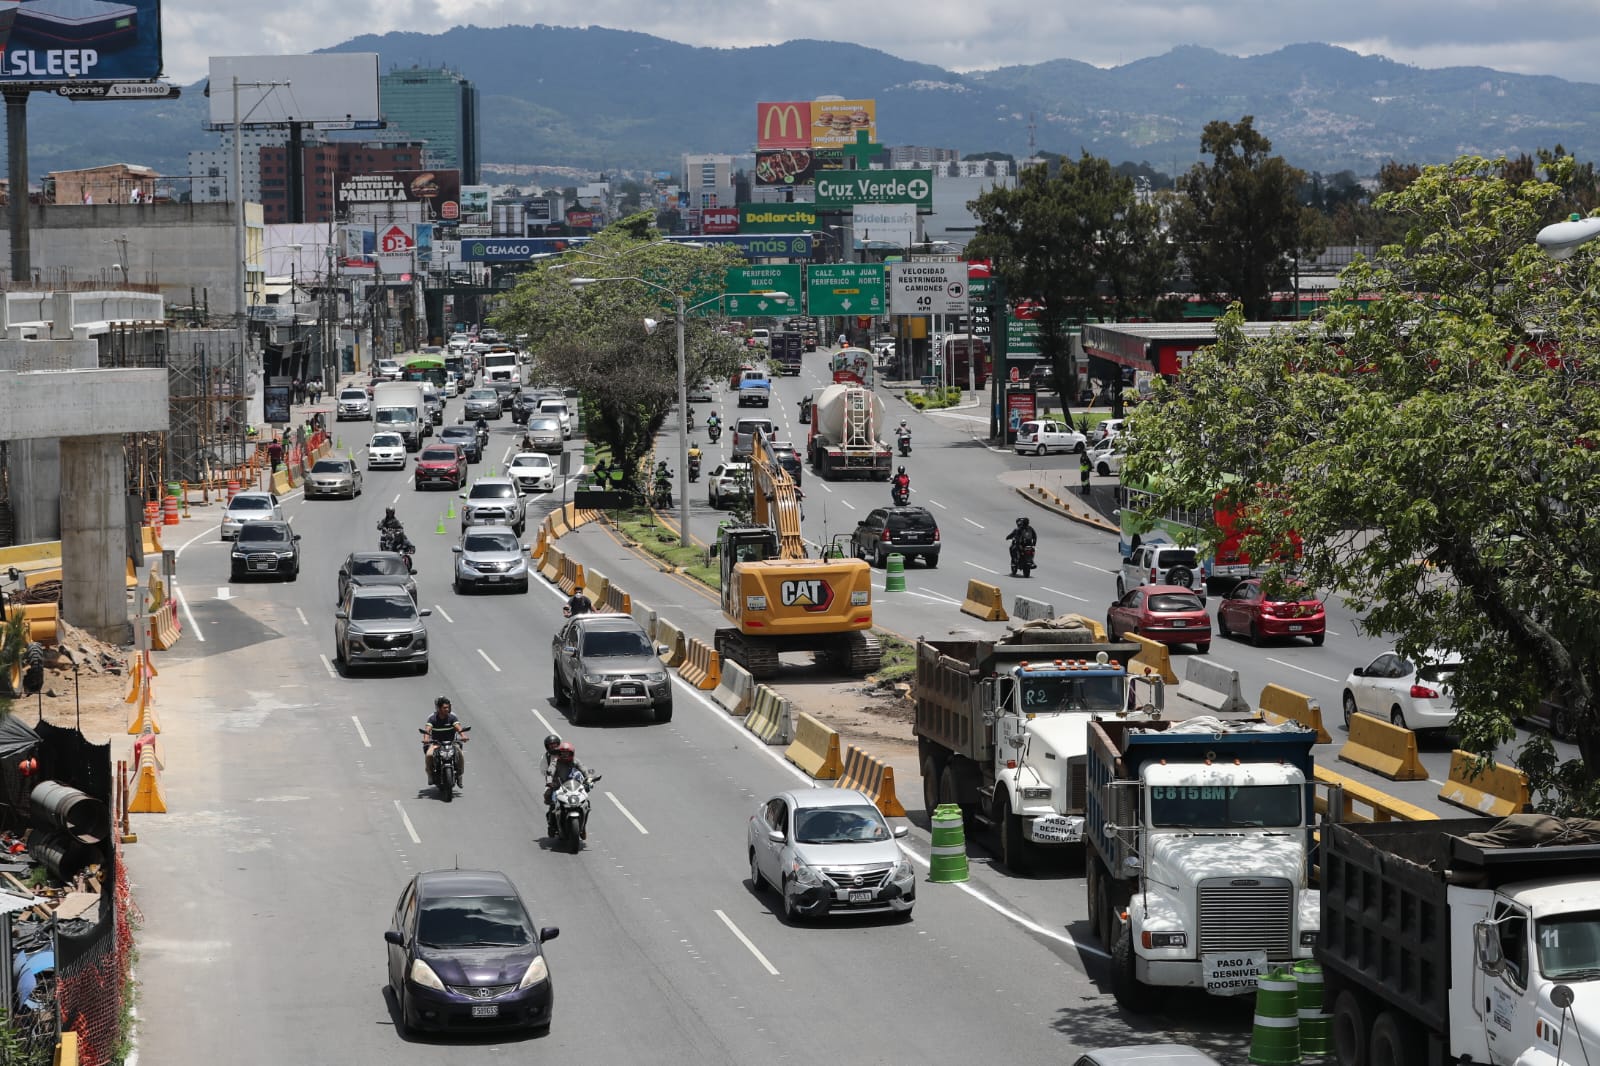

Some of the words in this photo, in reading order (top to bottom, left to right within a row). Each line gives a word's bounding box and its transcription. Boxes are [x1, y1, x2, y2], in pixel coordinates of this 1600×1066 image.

[10, 49, 98, 75] SLEEP
[341, 182, 357, 190] LOS
[818, 180, 854, 197] Cruz
[858, 178, 906, 196] Verde
[339, 189, 407, 201] PARRILLA
[704, 214, 740, 224] HIN
[746, 212, 816, 224] Dollarcity
[486, 245, 530, 255] CEMACO
[750, 237, 787, 252] más
[811, 278, 850, 286] PERIFERICO
[858, 277, 881, 285] NORTE
[916, 296, 932, 305] 40
[781, 580, 821, 606] CAT
[1541, 929, 1559, 948] 11
[1217, 958, 1244, 968] PASO
[1245, 958, 1253, 966] A
[1212, 969, 1262, 979] DESNIVEL
[1207, 979, 1259, 990] ROOSEVEL
